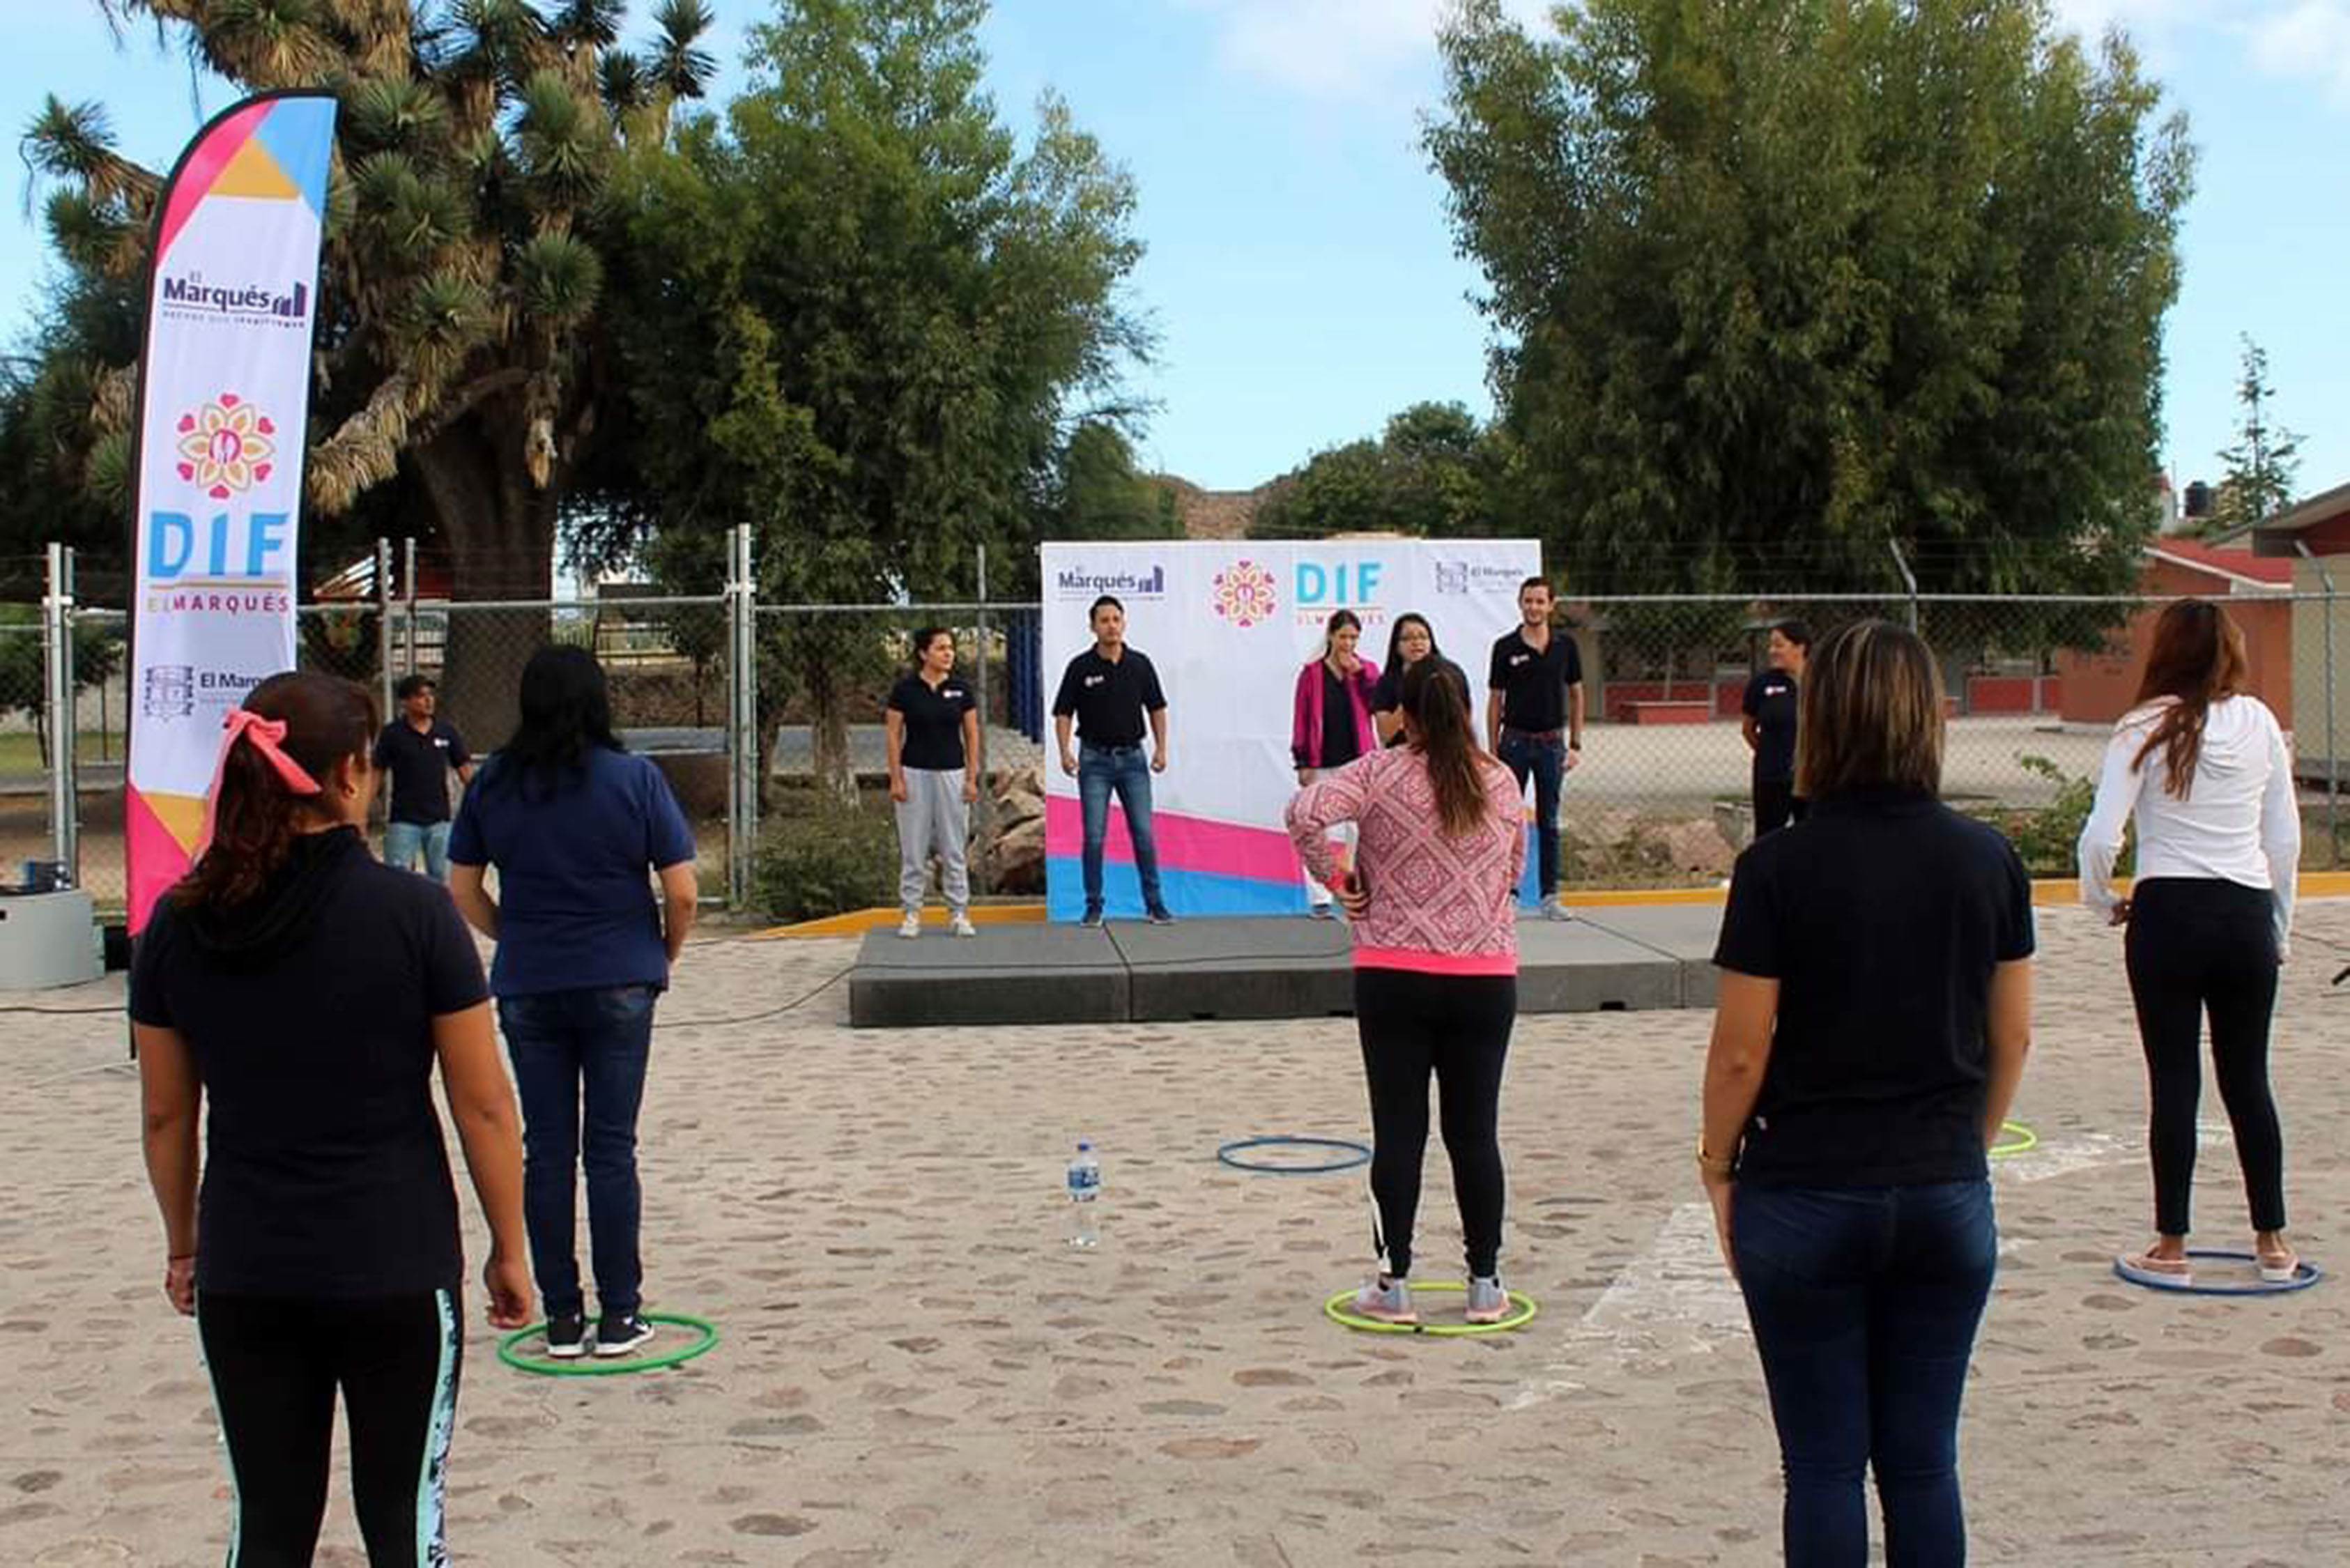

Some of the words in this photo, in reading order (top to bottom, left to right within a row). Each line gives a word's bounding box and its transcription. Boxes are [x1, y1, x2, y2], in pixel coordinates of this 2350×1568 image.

[164, 277, 270, 312] Marqués
[148, 512, 289, 576] DIF
[1059, 571, 1135, 592] Marqués
[1297, 562, 1381, 604] DIF
[200, 672, 215, 688] El
